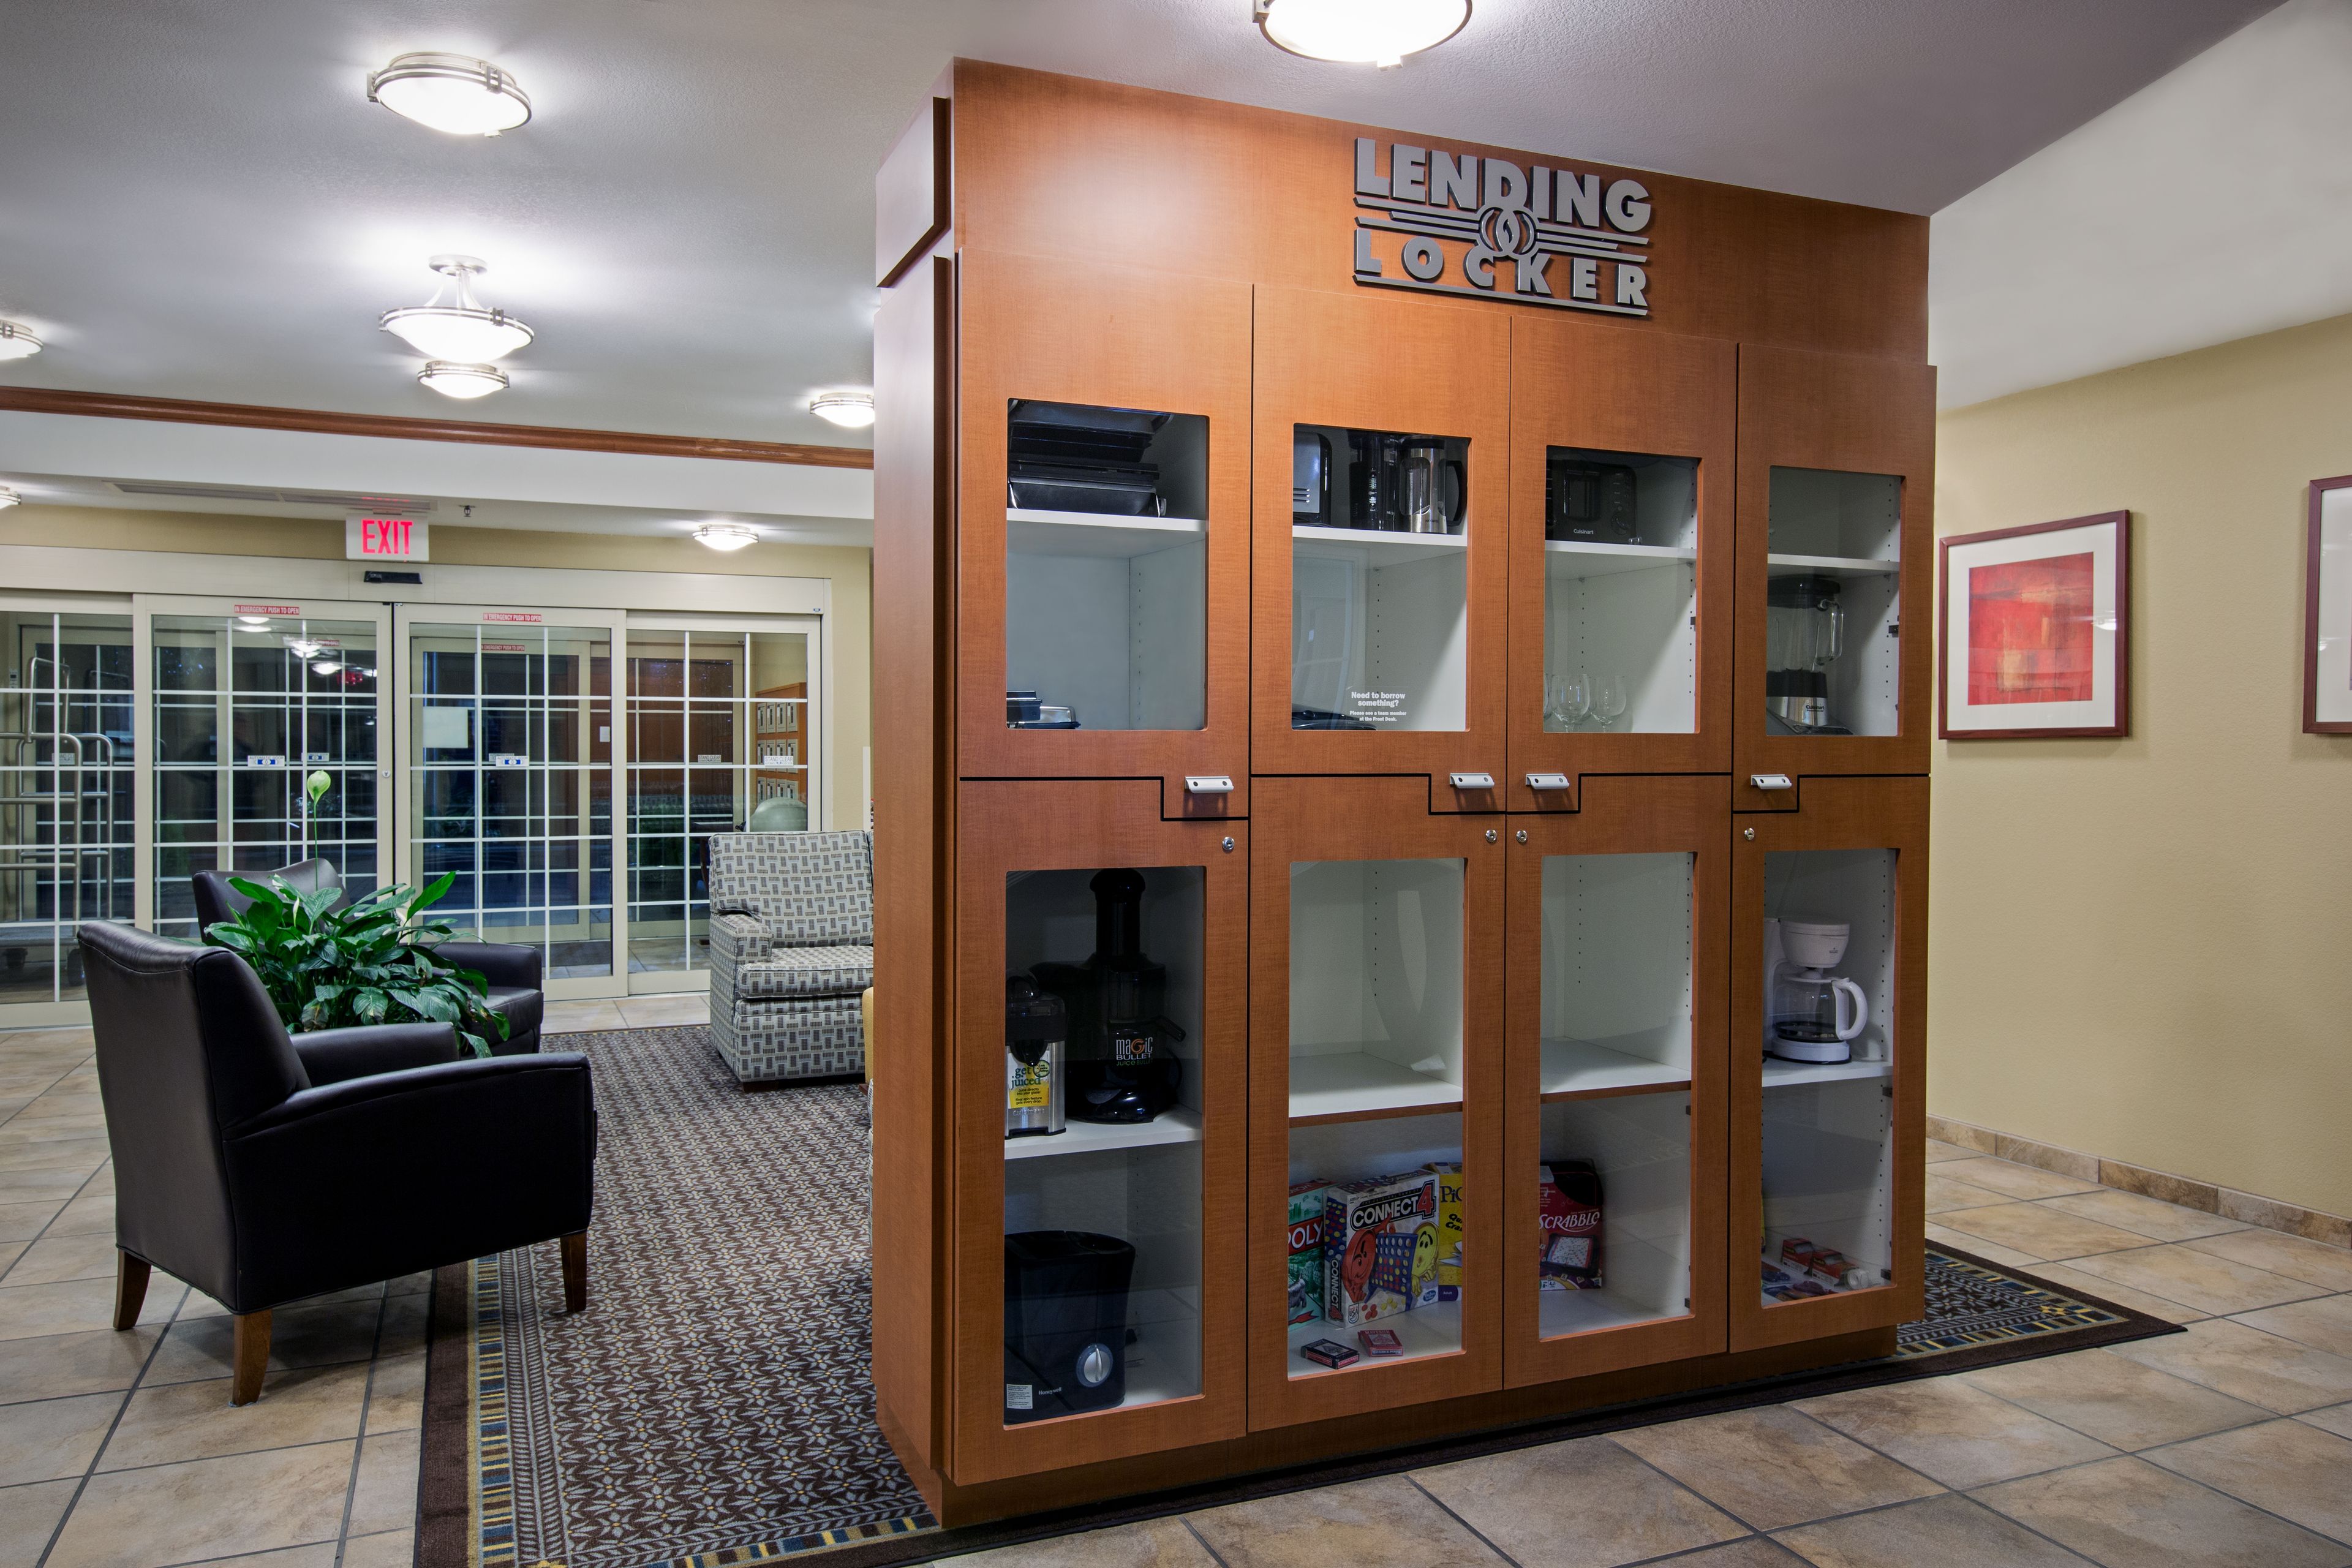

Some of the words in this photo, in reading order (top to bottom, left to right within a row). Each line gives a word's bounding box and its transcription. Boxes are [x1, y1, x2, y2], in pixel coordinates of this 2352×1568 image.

[1355, 137, 1651, 232] LENDING
[1354, 228, 1648, 307] LOCKER
[362, 519, 413, 554] EXIT
[1011, 1074, 1041, 1090] juiced
[1015, 1067, 1032, 1079] get
[1352, 1196, 1419, 1227] CONNECT
[1417, 1185, 1434, 1215] 4
[1038, 1387, 1062, 1395] Honeywell
